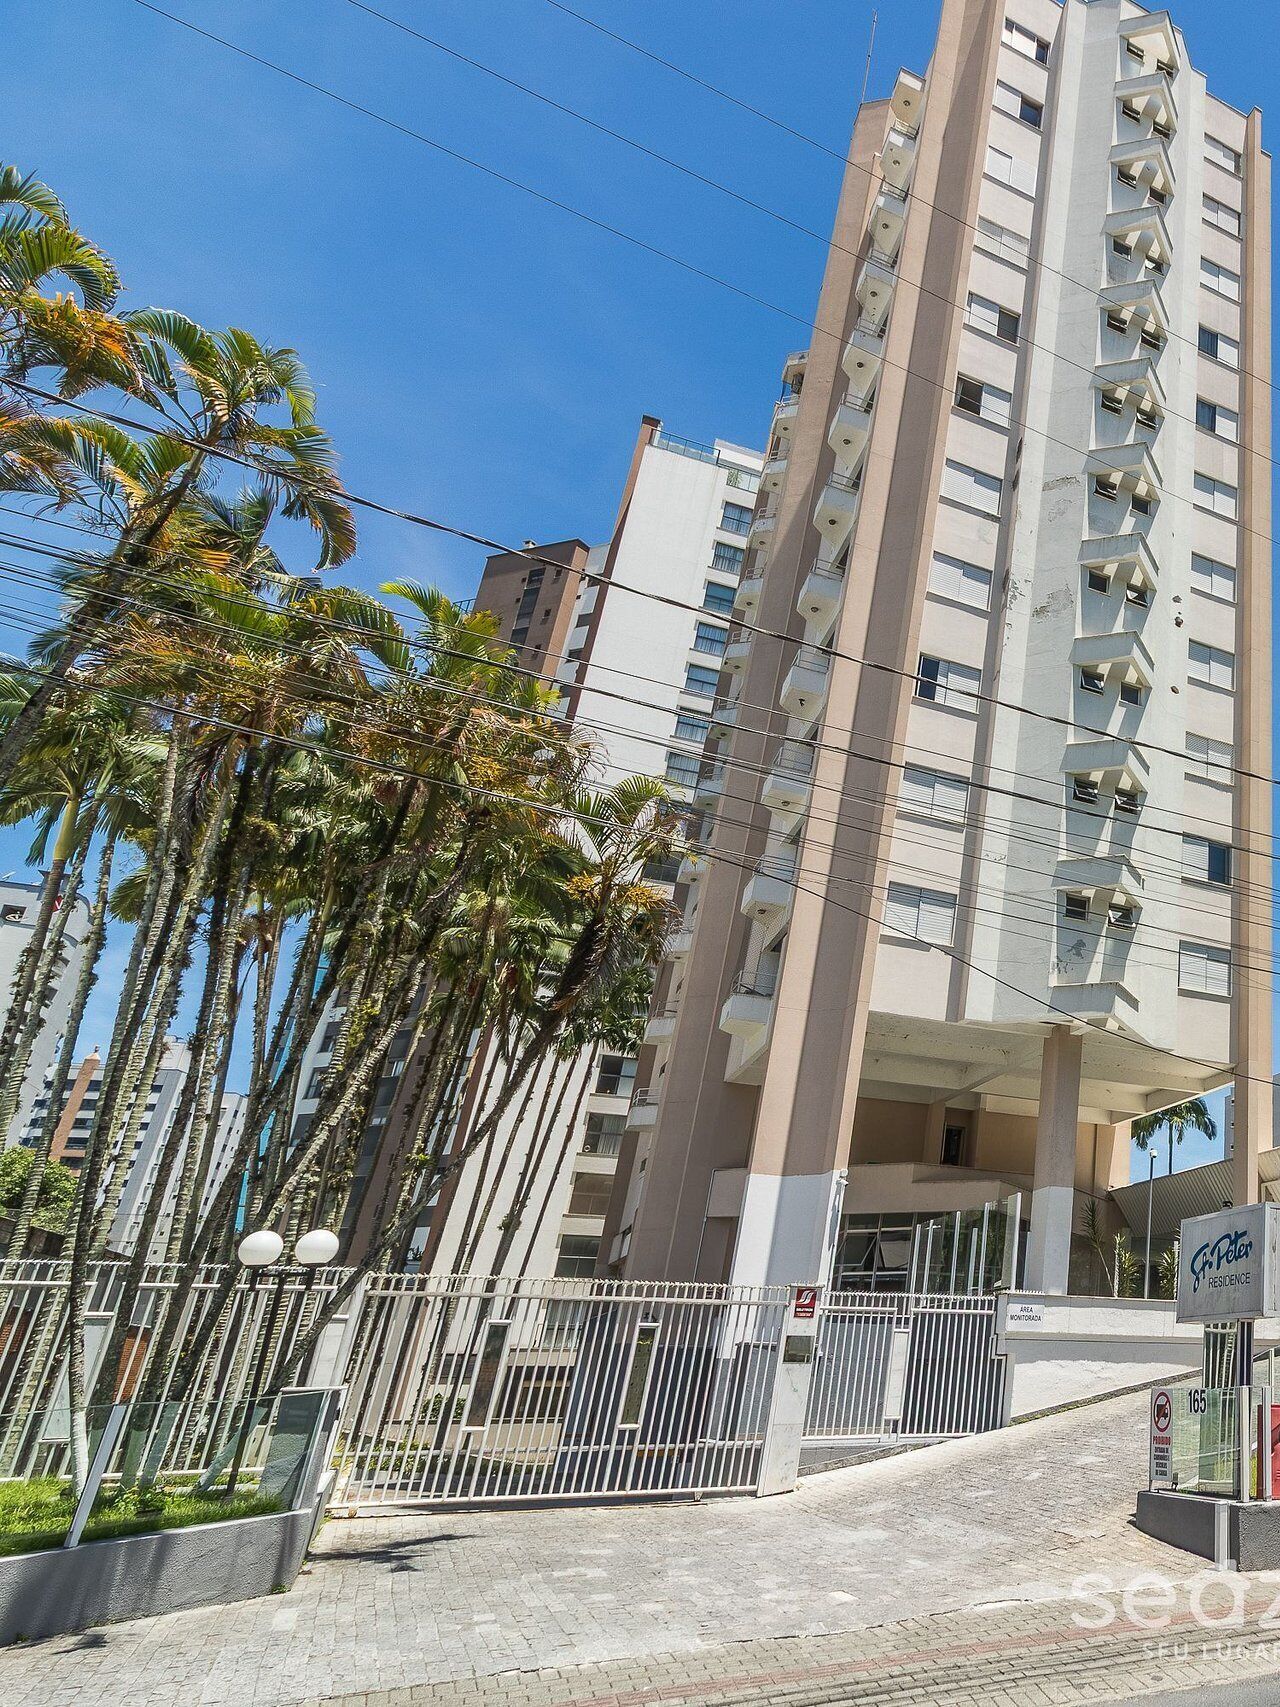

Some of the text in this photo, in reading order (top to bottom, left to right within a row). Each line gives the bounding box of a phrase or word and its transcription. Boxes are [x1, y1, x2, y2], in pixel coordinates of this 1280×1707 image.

[1210, 1230, 1253, 1271] Peter
[1208, 1272, 1251, 1289] RESIDENCE
[1010, 1314, 1042, 1322] MONITORADA
[1188, 1389, 1207, 1414] 165
